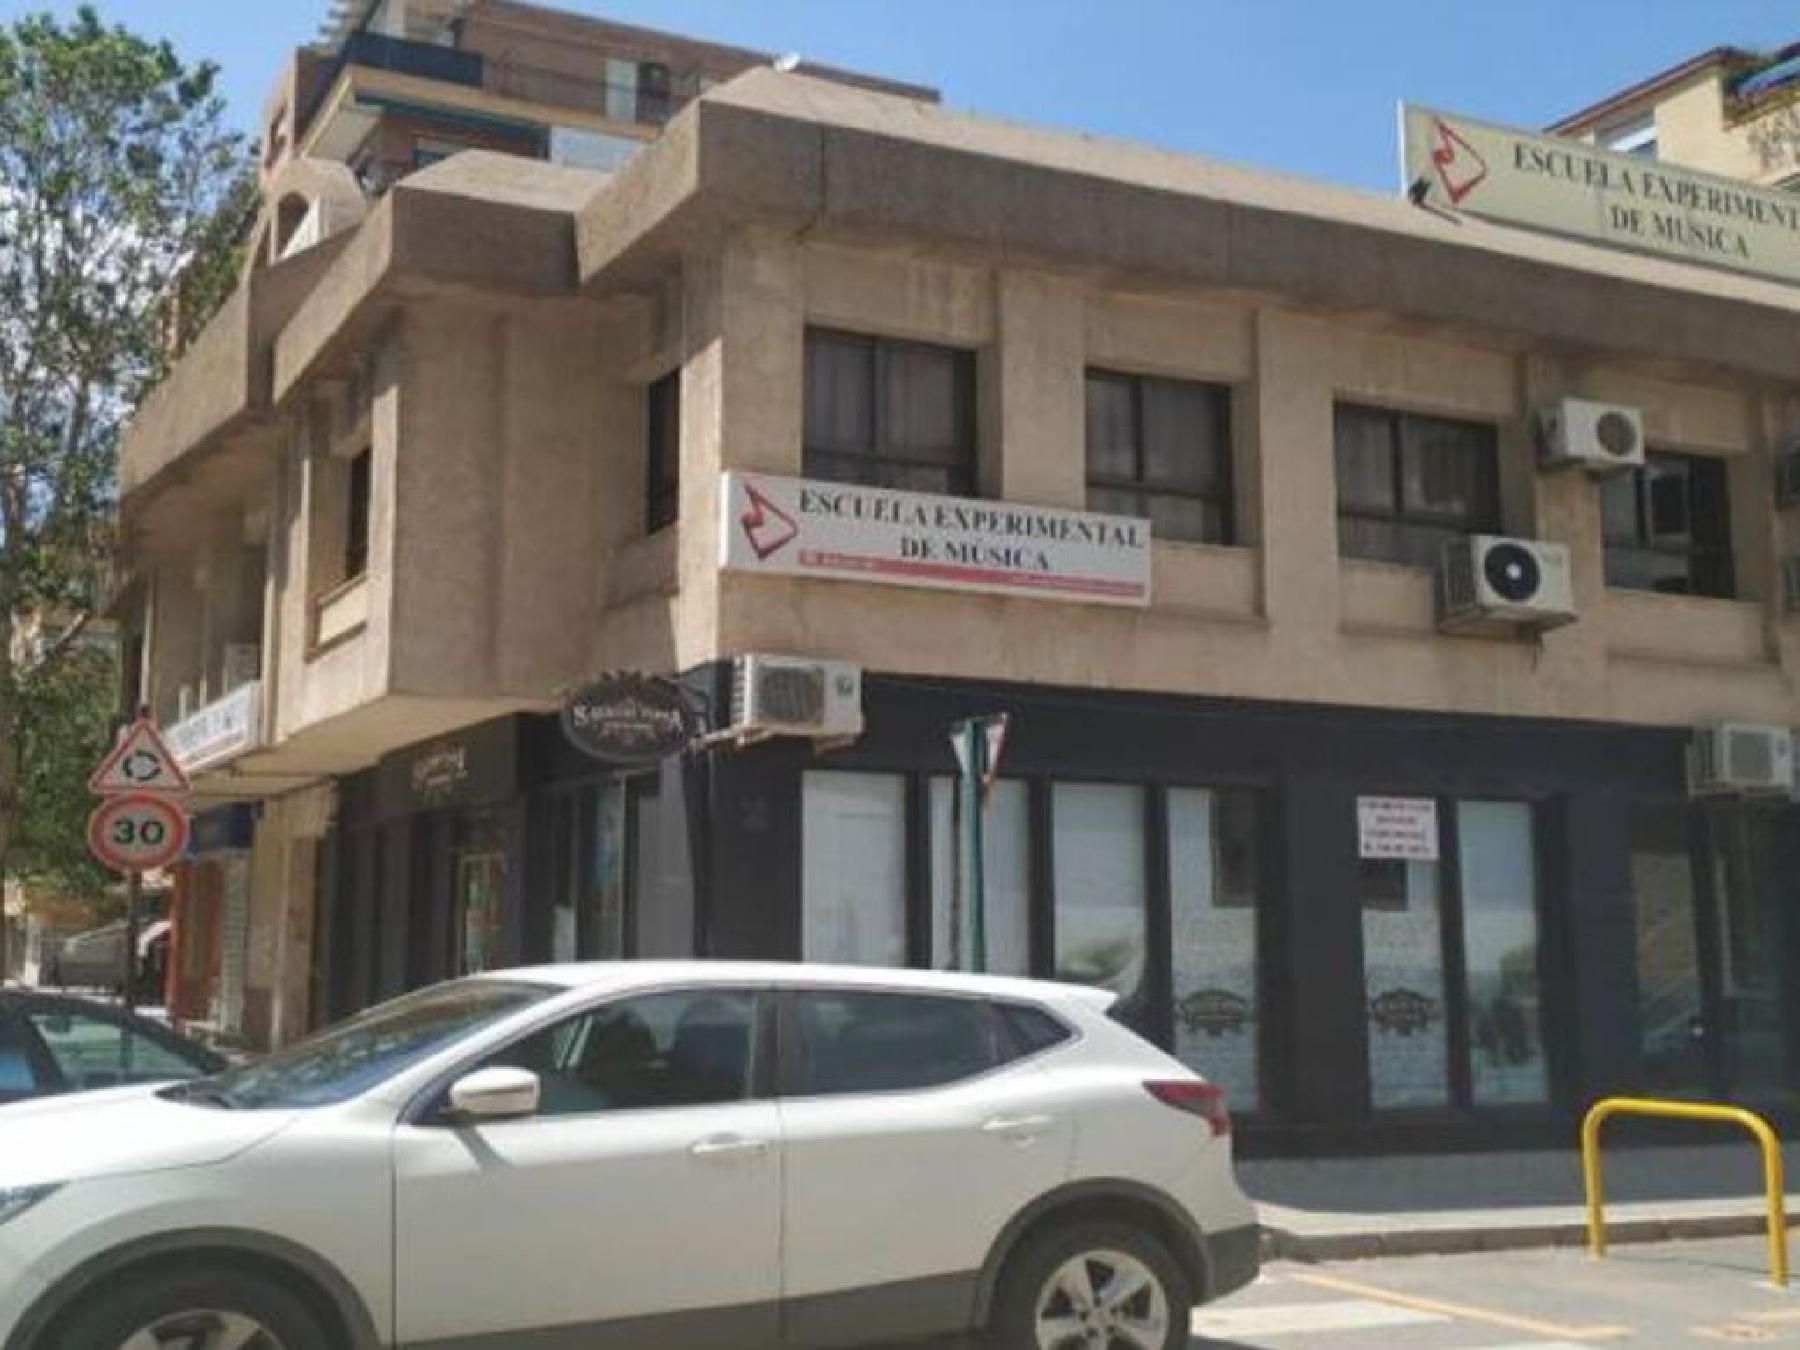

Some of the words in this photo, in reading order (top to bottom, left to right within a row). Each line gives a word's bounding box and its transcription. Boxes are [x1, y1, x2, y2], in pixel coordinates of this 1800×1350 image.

[1514, 143, 1637, 196] ESCUELA
[1610, 204, 1645, 236] DE
[800, 488, 928, 528] ESCUELA
[935, 500, 1144, 549] EXPERIMENTAL
[900, 536, 931, 560] DE
[113, 819, 164, 844] 30
